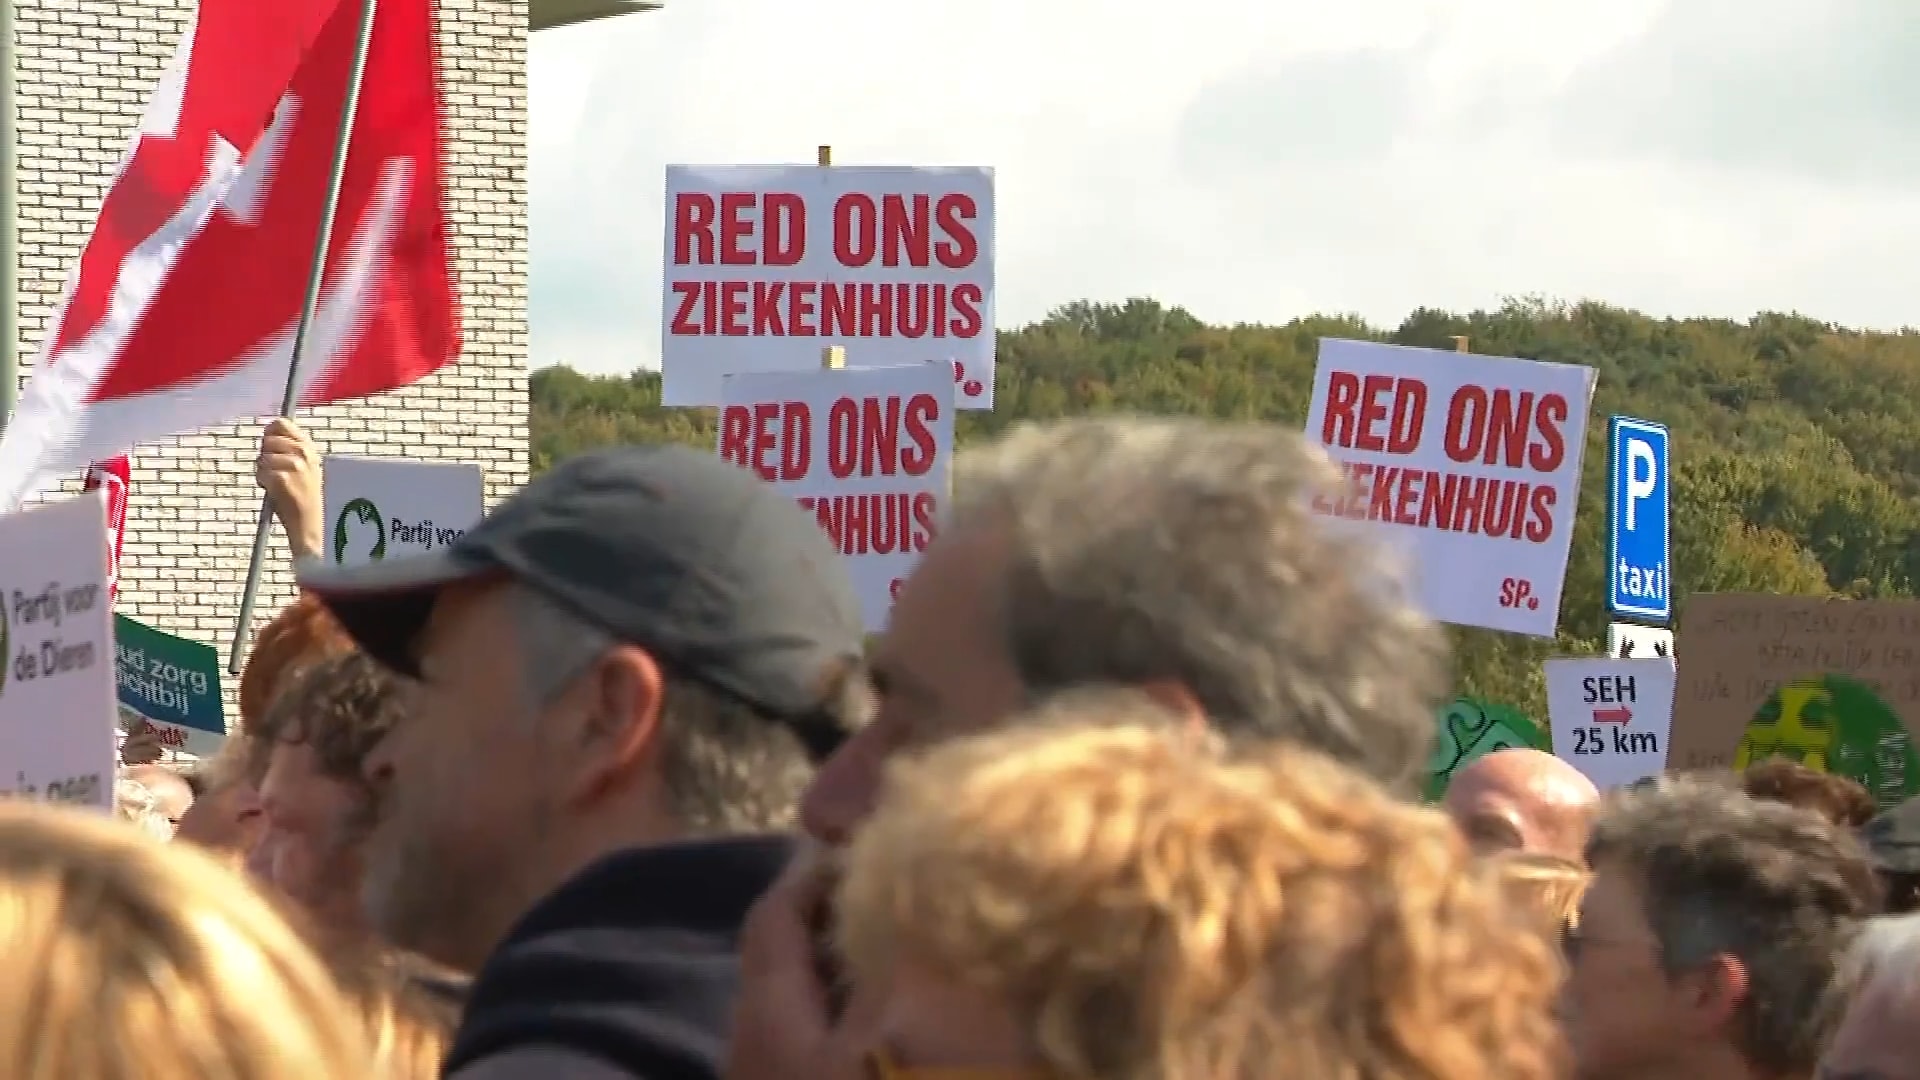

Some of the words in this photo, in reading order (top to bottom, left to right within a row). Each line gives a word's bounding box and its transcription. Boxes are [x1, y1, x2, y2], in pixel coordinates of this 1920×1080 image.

[674, 192, 806, 266] RED
[833, 192, 978, 269] ONS
[671, 281, 983, 339] ZIEKENHUIS
[720, 401, 811, 482] RED
[828, 393, 939, 479] ONS
[1322, 370, 1428, 455] RED
[1444, 384, 1568, 473] ONS
[1626, 437, 1657, 531] P
[391, 516, 433, 550] Partij
[797, 491, 938, 555] NHUIS
[1619, 555, 1664, 599] taxi
[13, 582, 61, 628] Partij
[15, 644, 37, 681] de
[150, 658, 208, 695] zorg
[1583, 675, 1636, 703] SEH
[1572, 727, 1604, 754] 25
[1613, 726, 1658, 754] km
